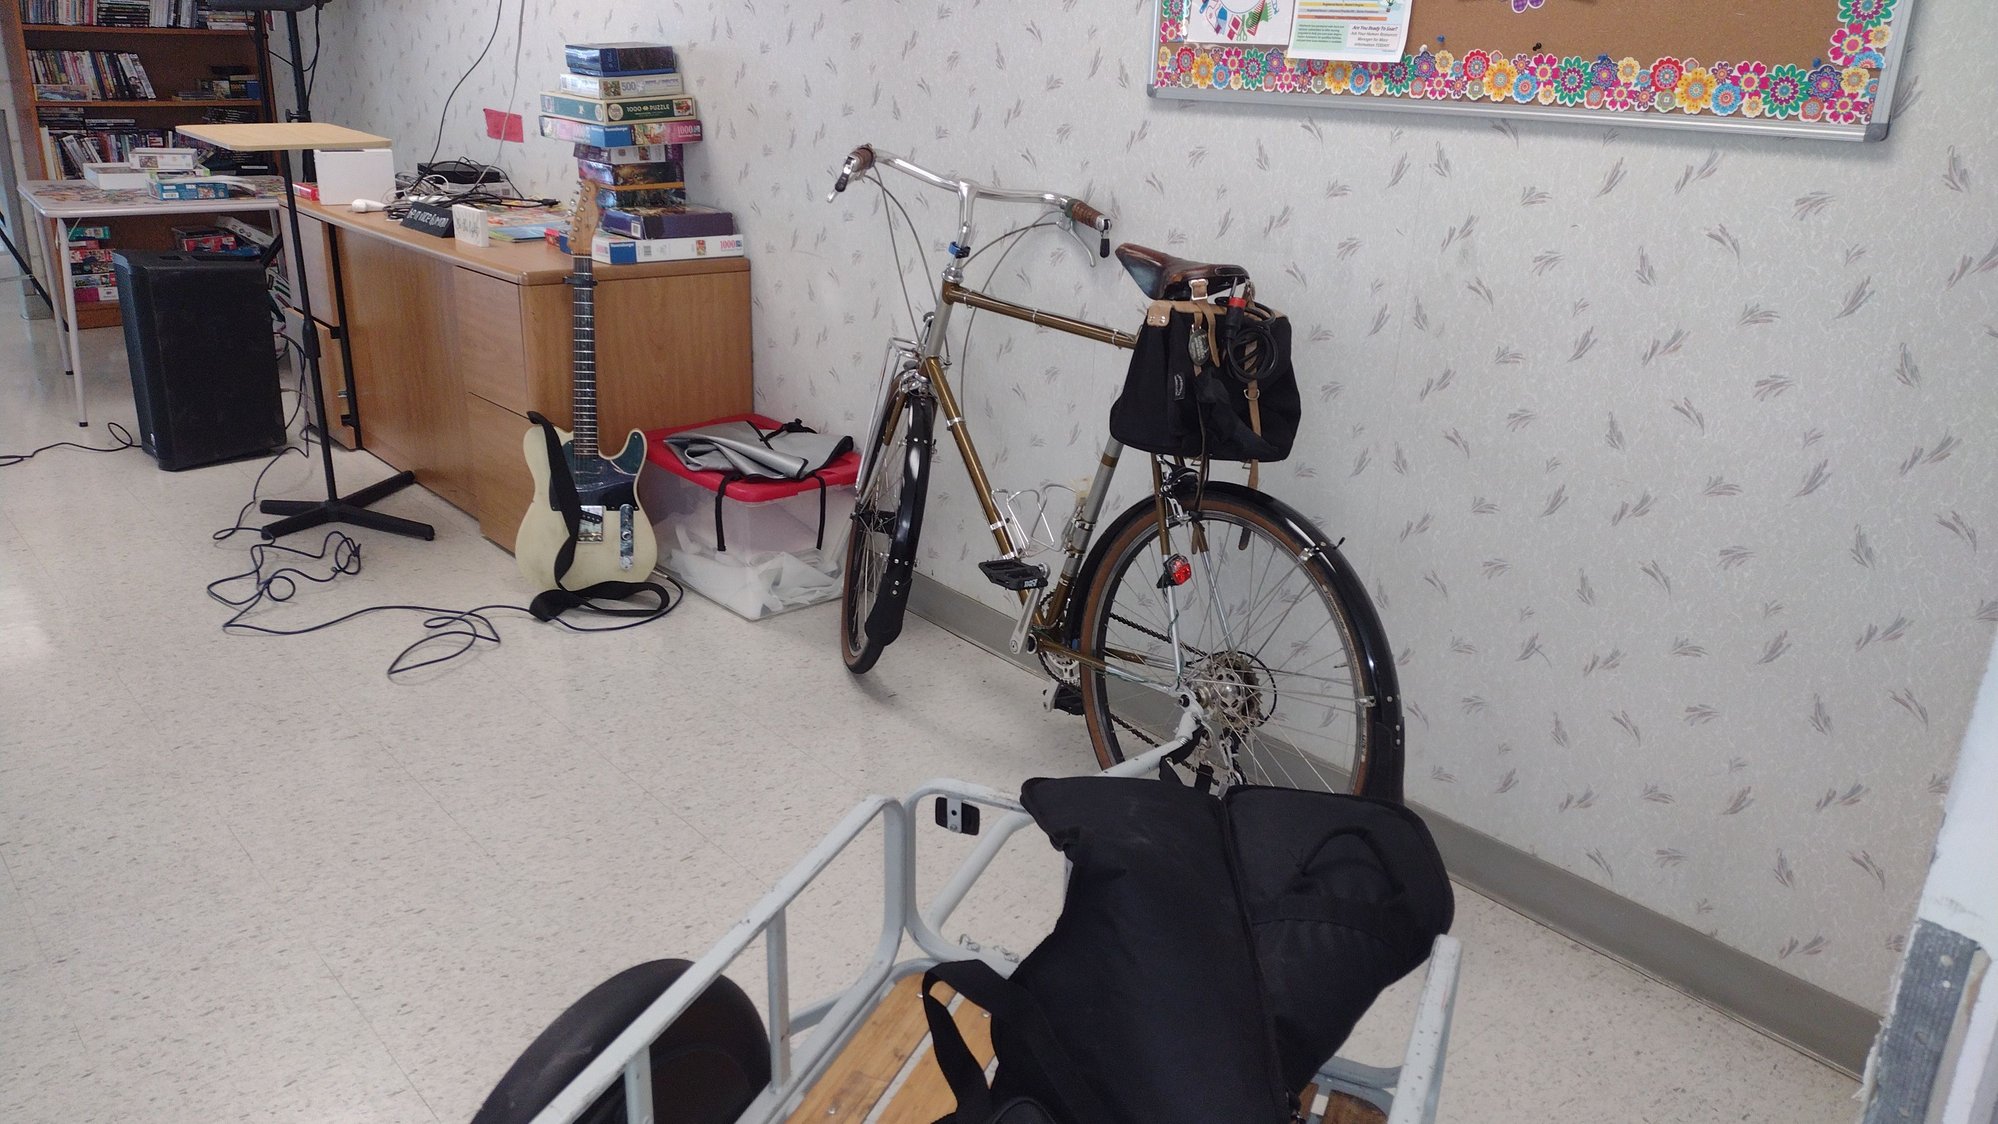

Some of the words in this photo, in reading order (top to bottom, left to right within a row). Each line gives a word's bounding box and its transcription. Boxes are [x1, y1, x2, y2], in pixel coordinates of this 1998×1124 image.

[621, 81, 637, 91] 500
[677, 125, 693, 134] 1000
[720, 240, 736, 249] 1000
